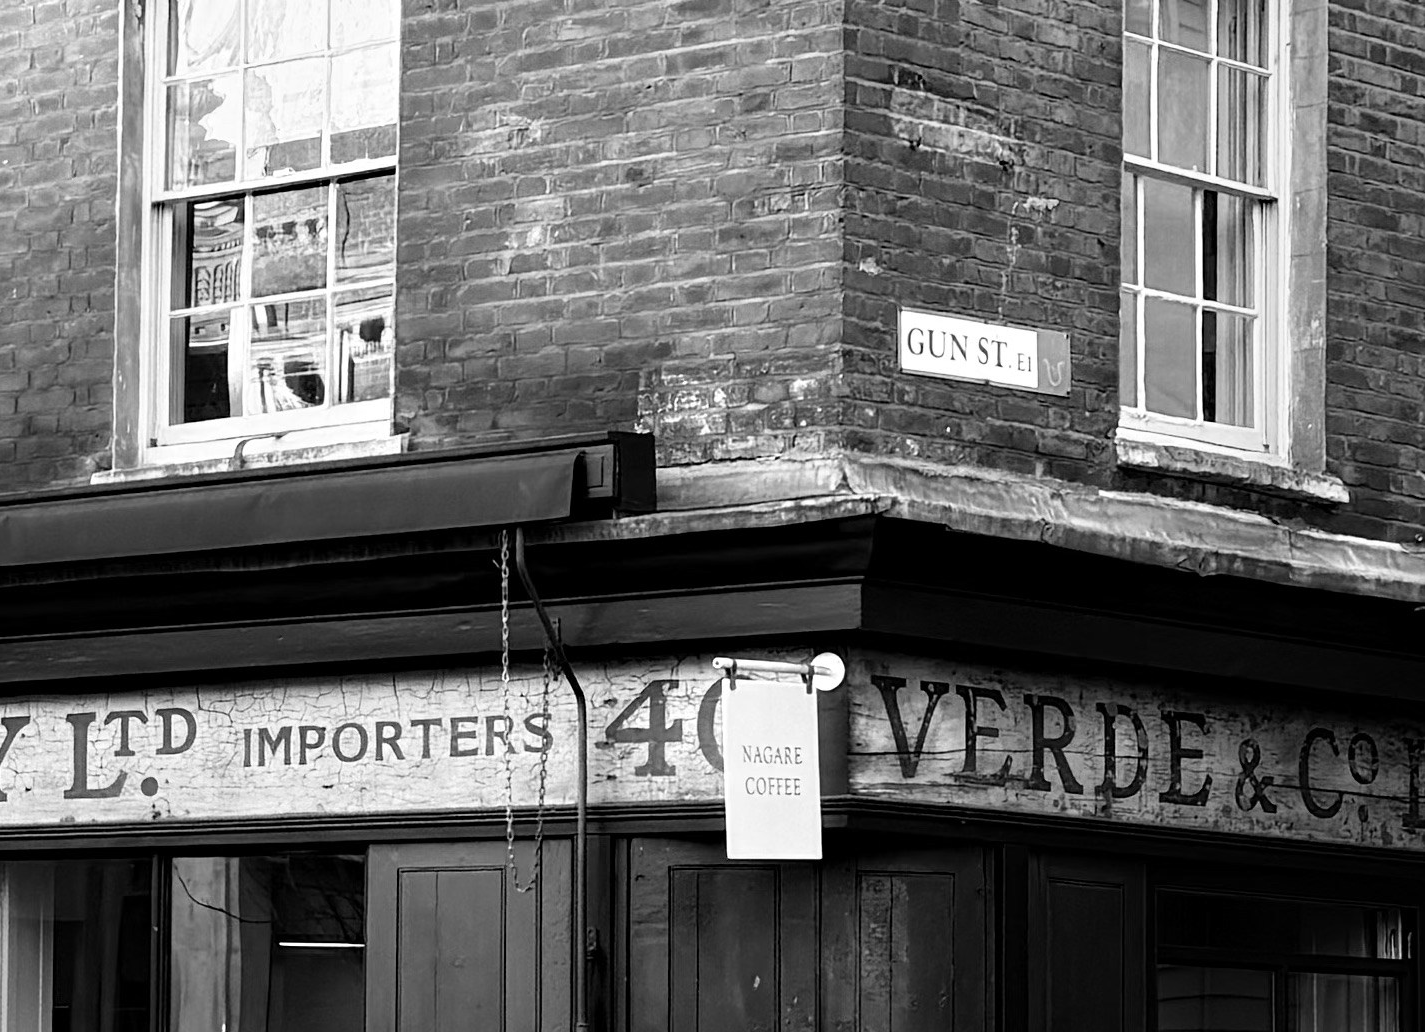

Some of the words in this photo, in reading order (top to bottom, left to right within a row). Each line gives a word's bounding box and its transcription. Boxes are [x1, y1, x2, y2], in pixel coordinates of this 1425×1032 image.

[906, 326, 968, 361] GUN
[977, 336, 1013, 369] ST.
[1017, 352, 1032, 372] E1
[242, 713, 554, 768] IMPORTERS
[741, 744, 803, 765] NAGARE
[870, 675, 1214, 807] VERDE
[1235, 737, 1277, 814] &
[744, 776, 801, 796] COFFEE
